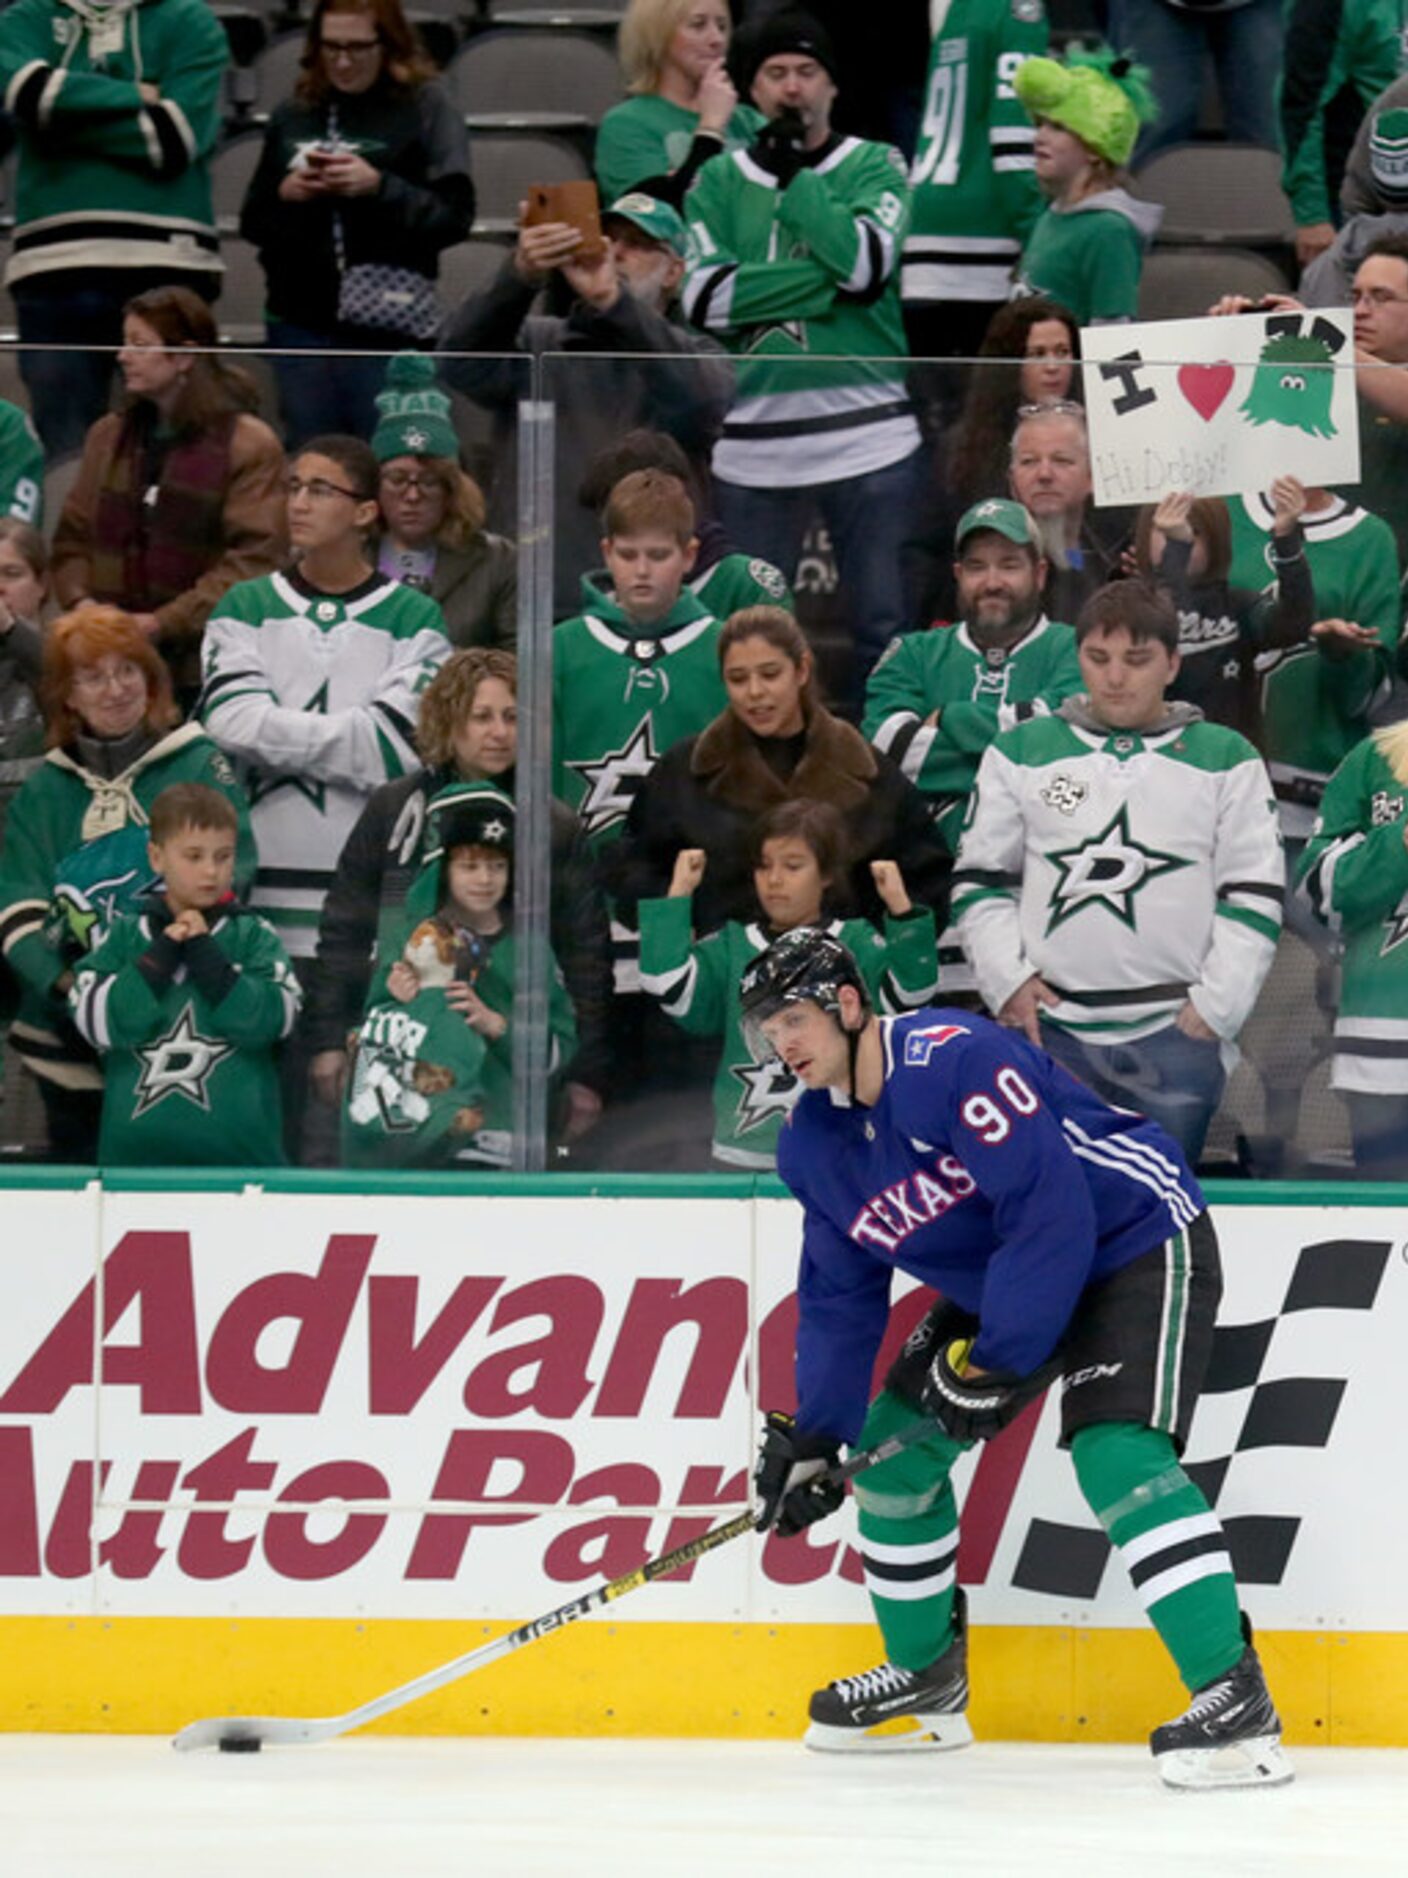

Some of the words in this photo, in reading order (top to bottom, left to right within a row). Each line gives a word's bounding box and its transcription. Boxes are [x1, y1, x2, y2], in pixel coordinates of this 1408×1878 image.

[908, 62, 968, 185] 91
[1099, 350, 1157, 416] I
[1095, 451, 1136, 499] Hi
[960, 1064, 1041, 1147] 90
[848, 1152, 978, 1253] TEXAS
[0, 1228, 941, 1421] Advan
[0, 1423, 393, 1581] uto
[402, 1428, 868, 1586] Par
